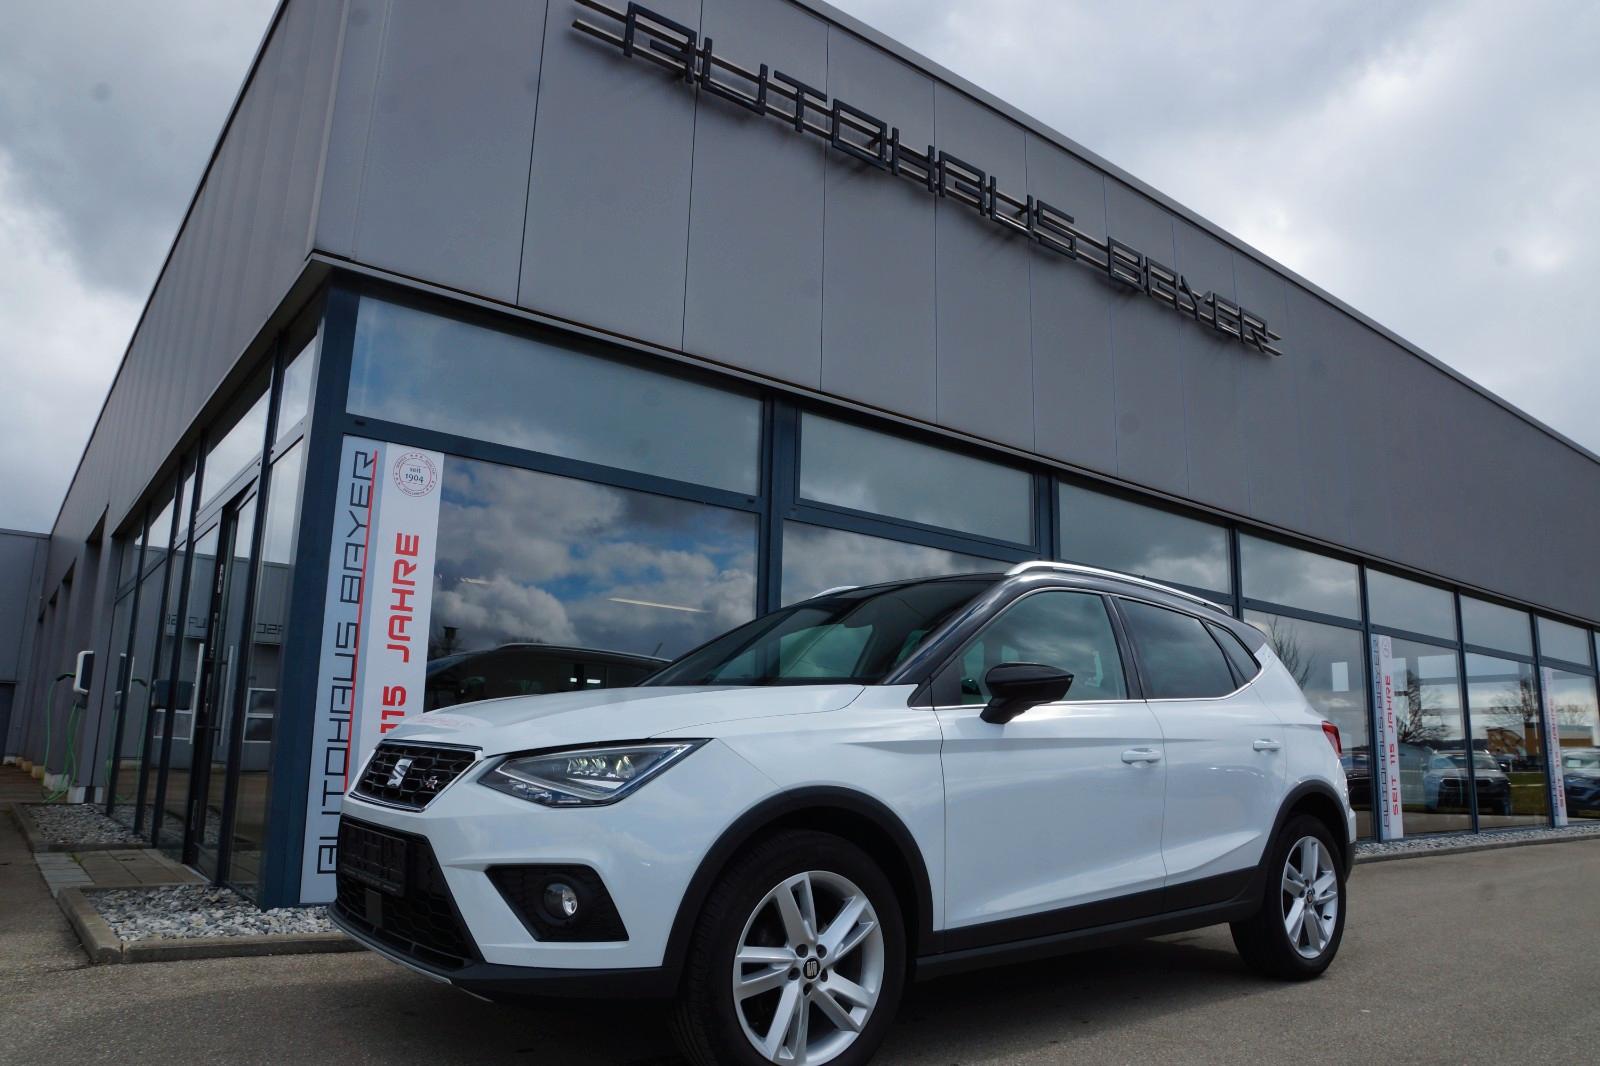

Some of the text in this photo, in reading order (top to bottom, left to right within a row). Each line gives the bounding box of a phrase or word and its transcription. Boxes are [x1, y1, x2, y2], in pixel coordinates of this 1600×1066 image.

[623, 1, 1269, 354] AUTOHAUS BAYER
[405, 473, 424, 484] 1904
[387, 532, 420, 663] JAHRE
[317, 451, 376, 874] AUTOHAUS BAYER
[380, 685, 407, 734] 115
[1385, 674, 1394, 734] JAHRE
[1391, 775, 1399, 816] SEIT
